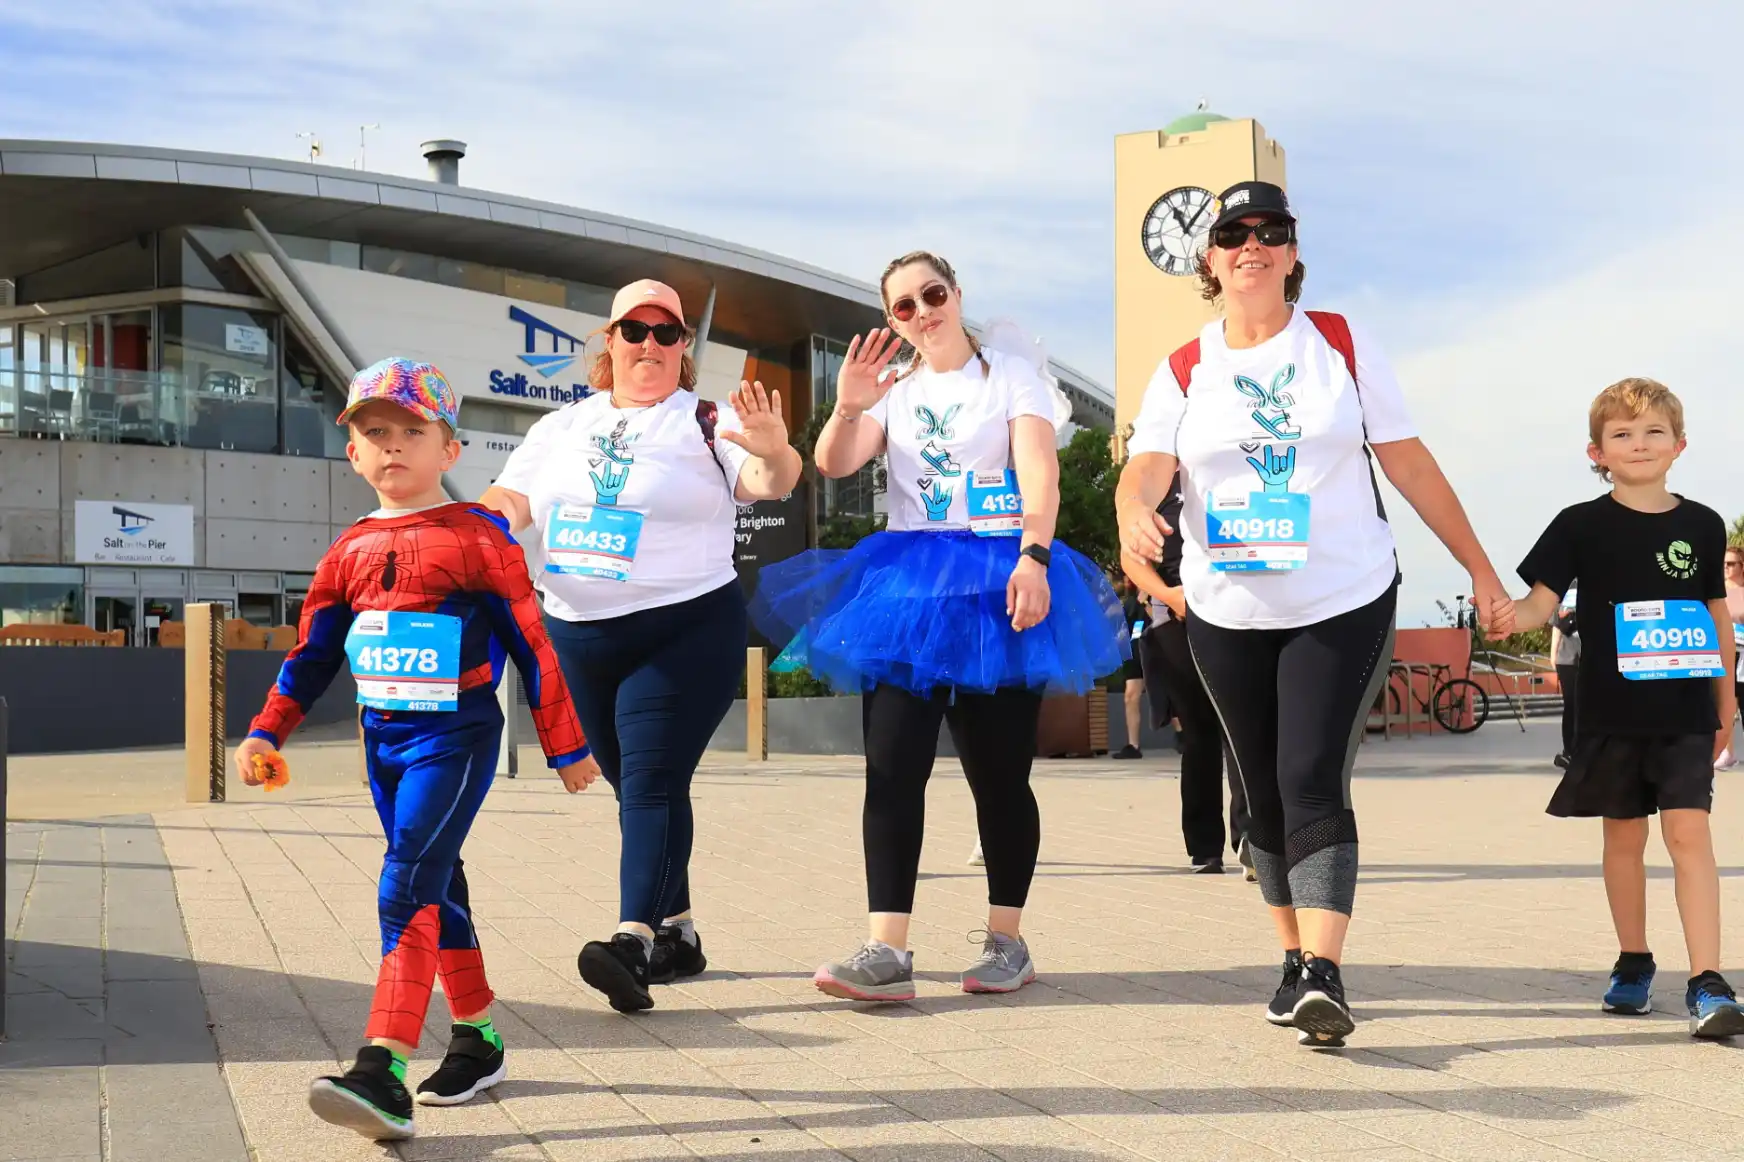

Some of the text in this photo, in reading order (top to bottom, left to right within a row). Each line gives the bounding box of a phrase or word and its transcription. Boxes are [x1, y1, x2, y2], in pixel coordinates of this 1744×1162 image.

[489, 369, 528, 398] Salt
[529, 384, 547, 400] on
[550, 385, 572, 404] the
[486, 441, 520, 452] resta
[740, 516, 785, 531] Brighton
[1218, 518, 1294, 540] 40918
[103, 537, 123, 549] Salt
[148, 539, 167, 550] Pier
[555, 528, 627, 552] 40433
[735, 532, 752, 545] ary
[1656, 553, 1679, 579] NINJA
[1631, 627, 1707, 649] 40919
[356, 646, 439, 673] 41378
[407, 701, 439, 711] 41378
